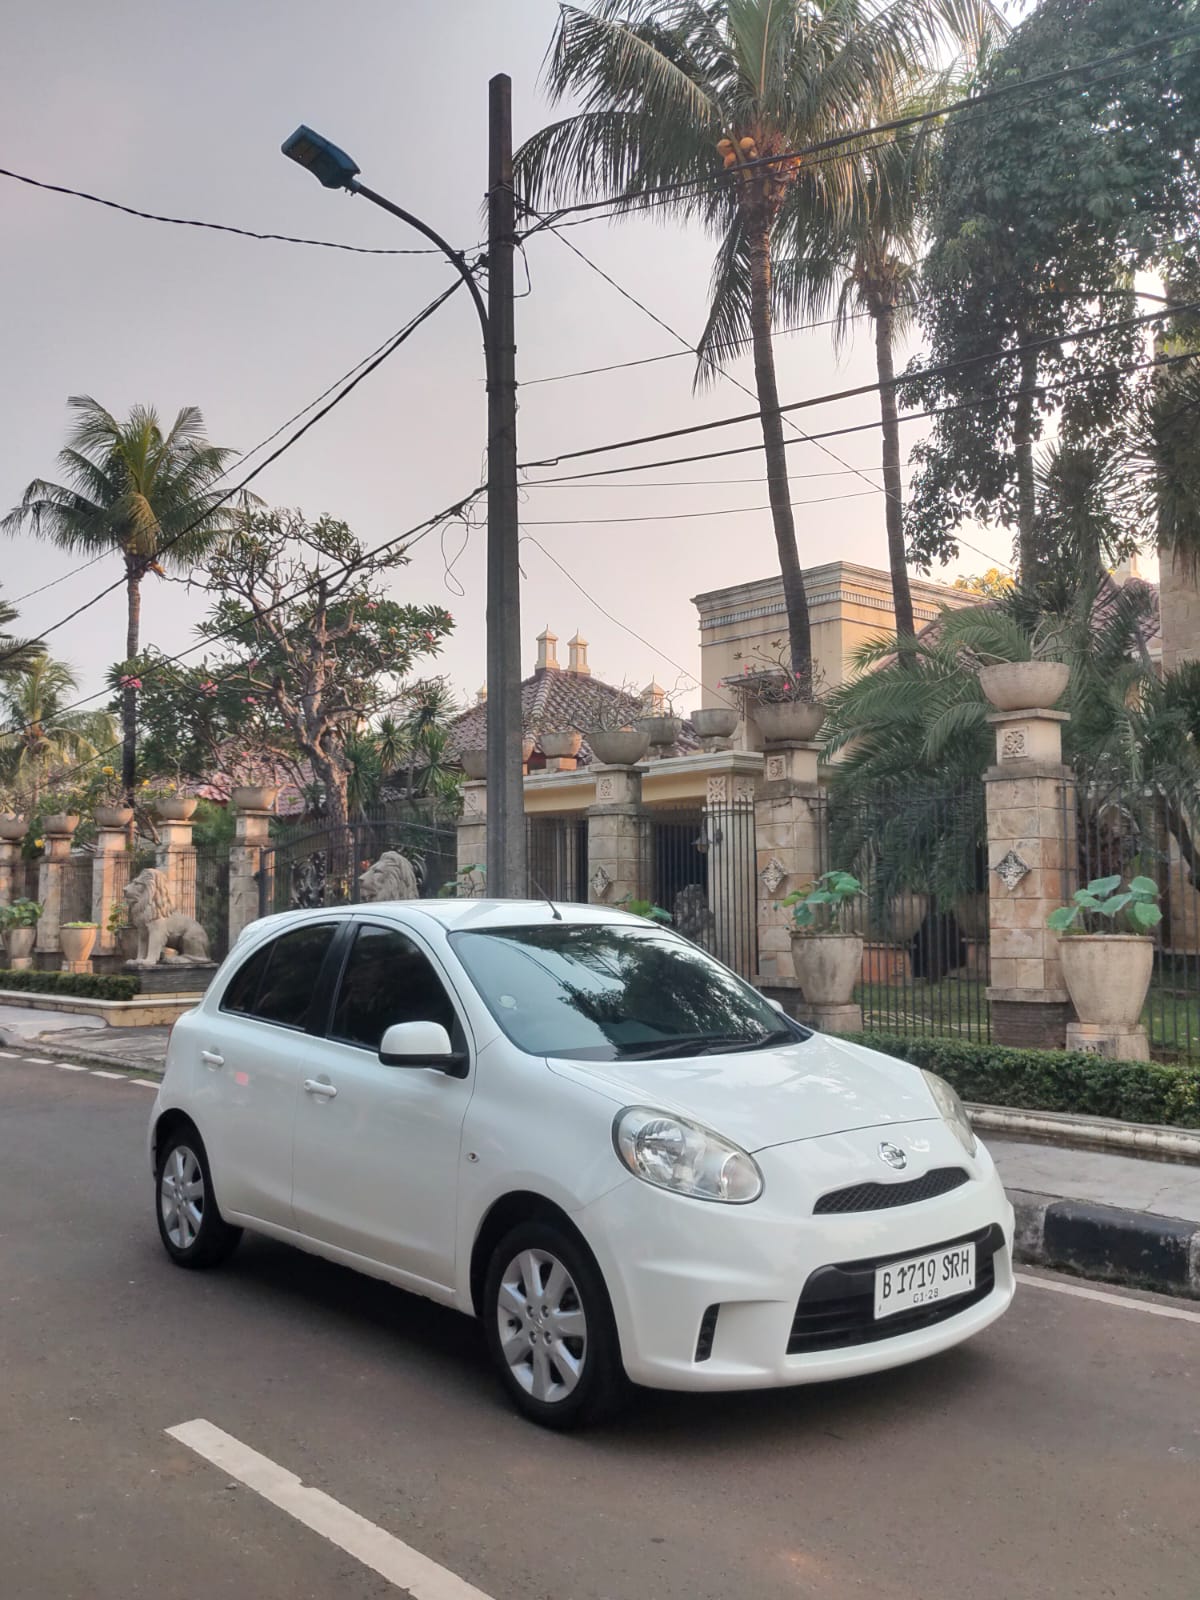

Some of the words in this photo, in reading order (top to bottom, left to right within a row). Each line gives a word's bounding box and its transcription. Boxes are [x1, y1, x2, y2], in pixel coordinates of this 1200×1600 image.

[883, 1271, 892, 1298] B
[896, 1258, 936, 1294] 1719
[942, 1248, 970, 1281] SRH
